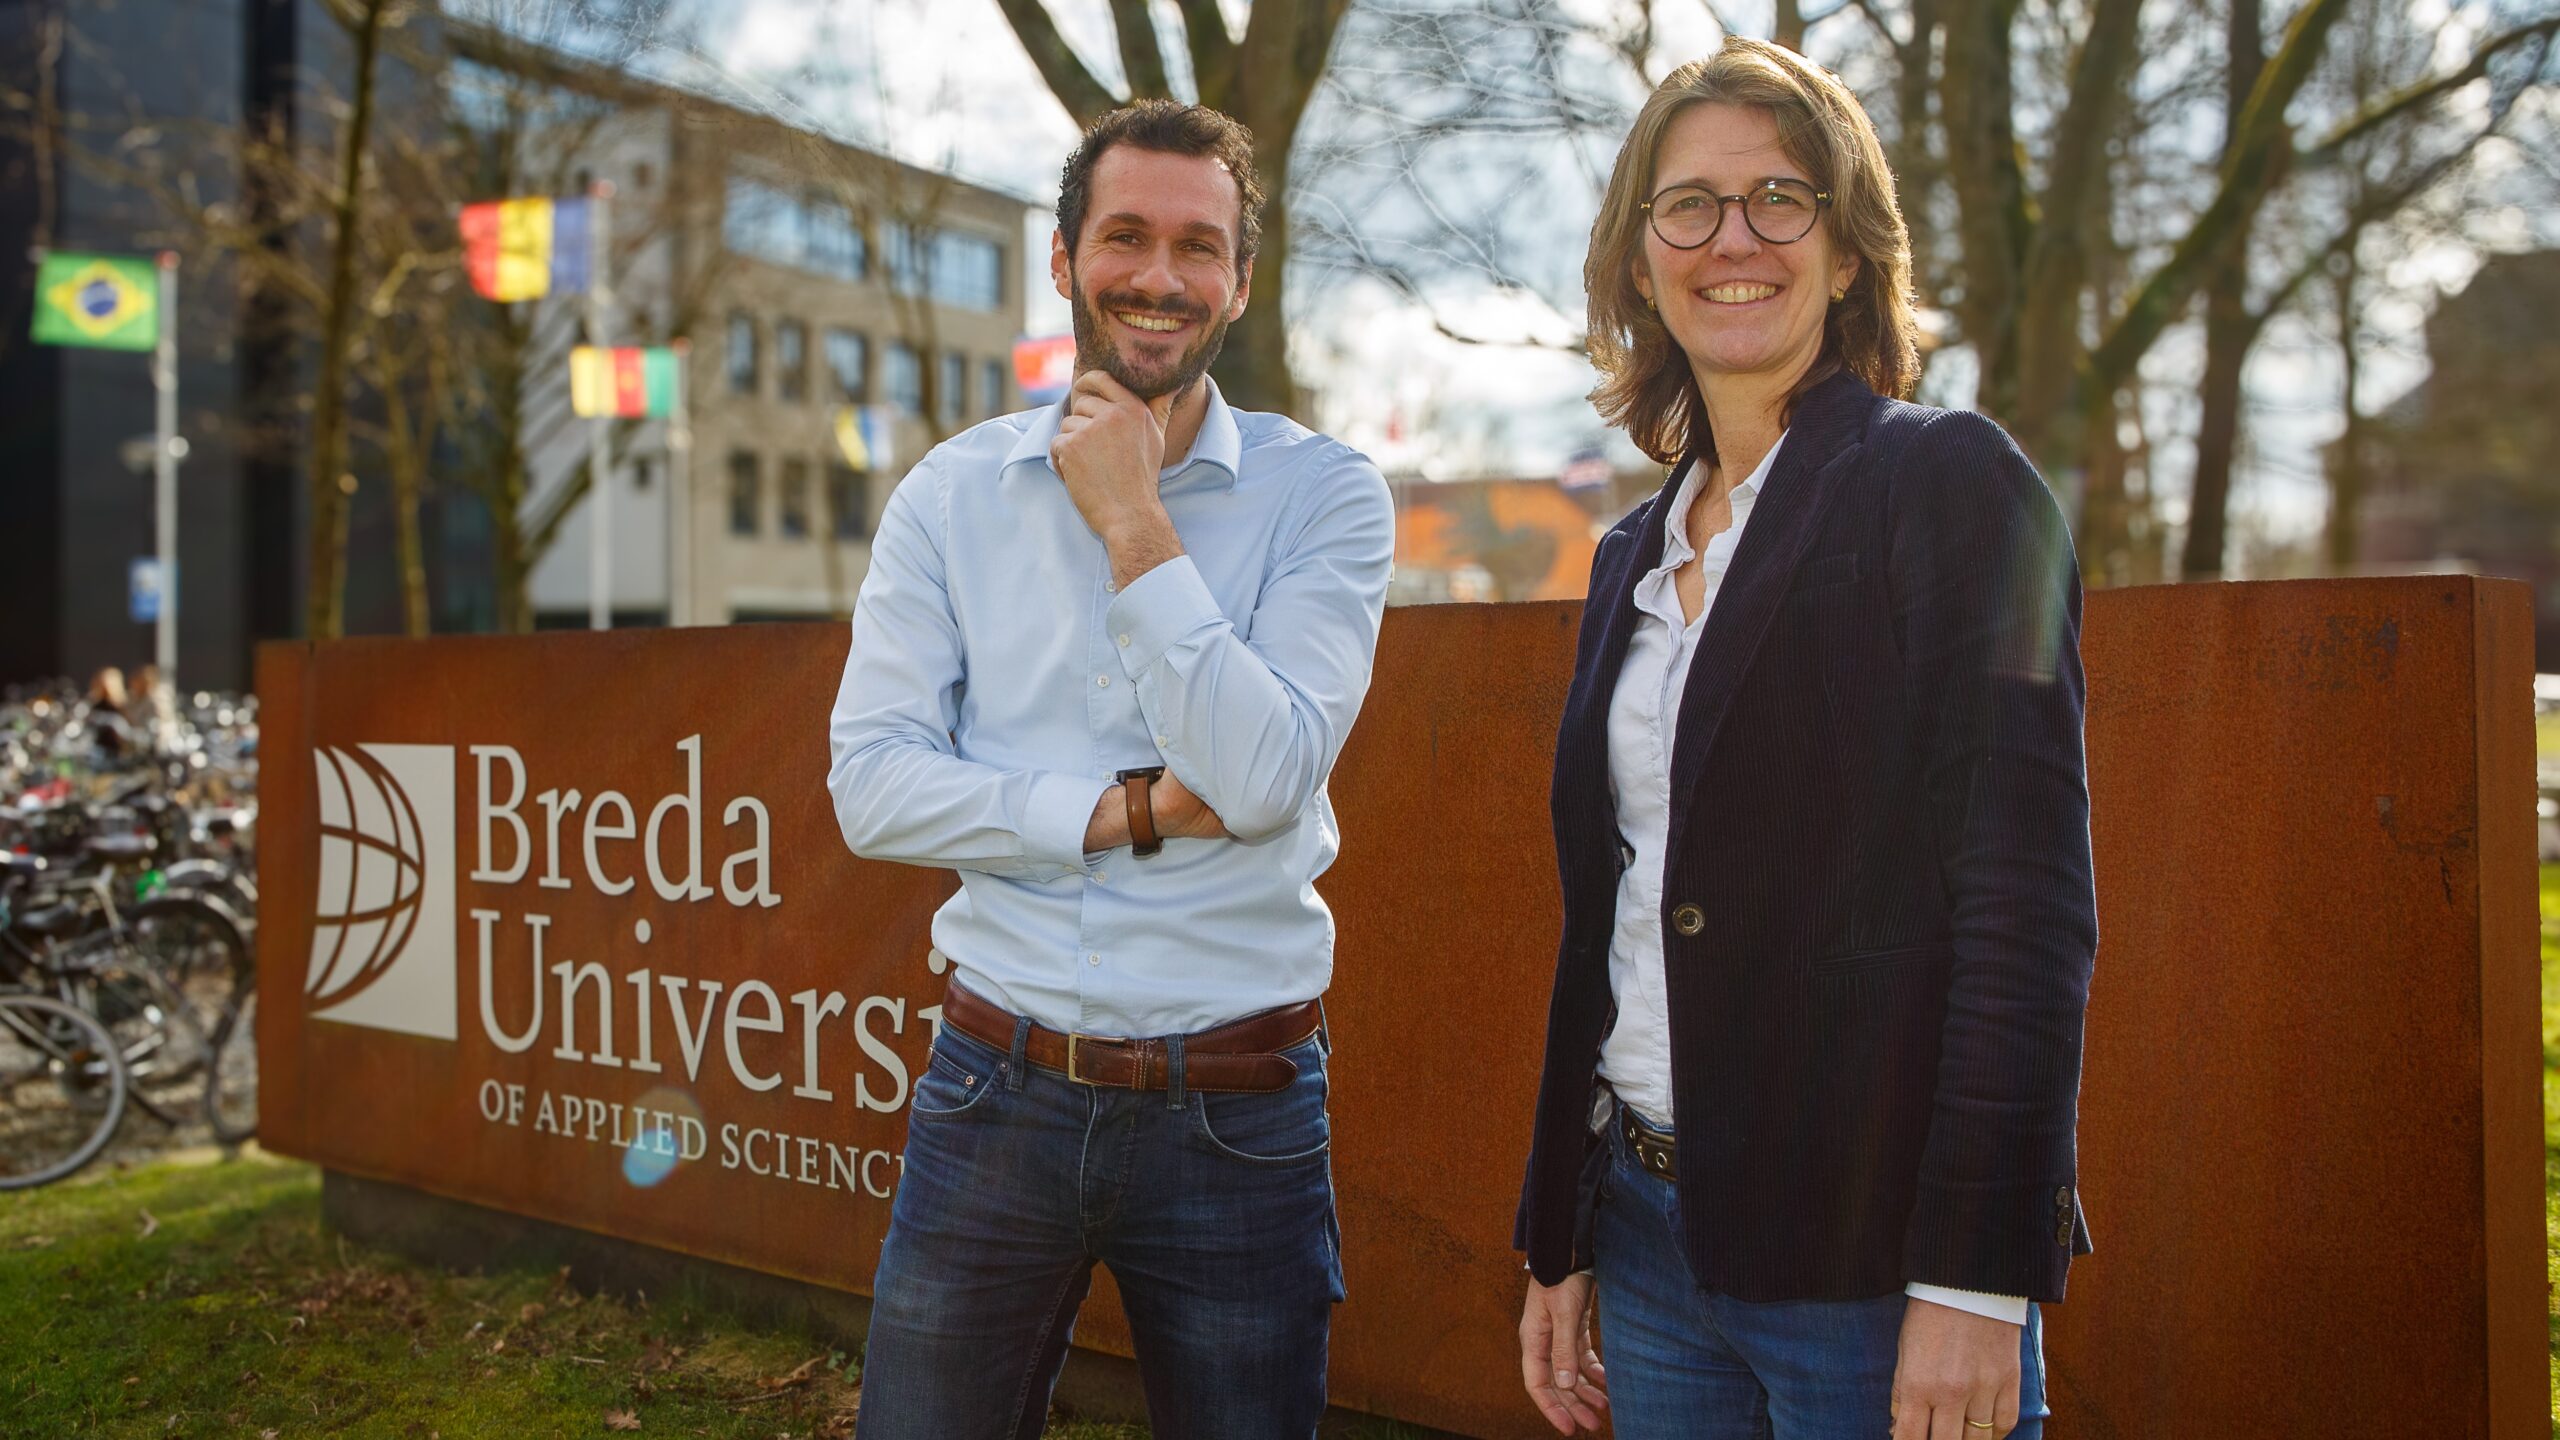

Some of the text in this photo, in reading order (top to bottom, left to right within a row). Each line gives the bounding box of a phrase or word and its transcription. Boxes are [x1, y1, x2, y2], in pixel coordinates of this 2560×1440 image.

[470, 734, 782, 908] Breda
[479, 1079, 905, 1198] OF APPLIED SCIENC
